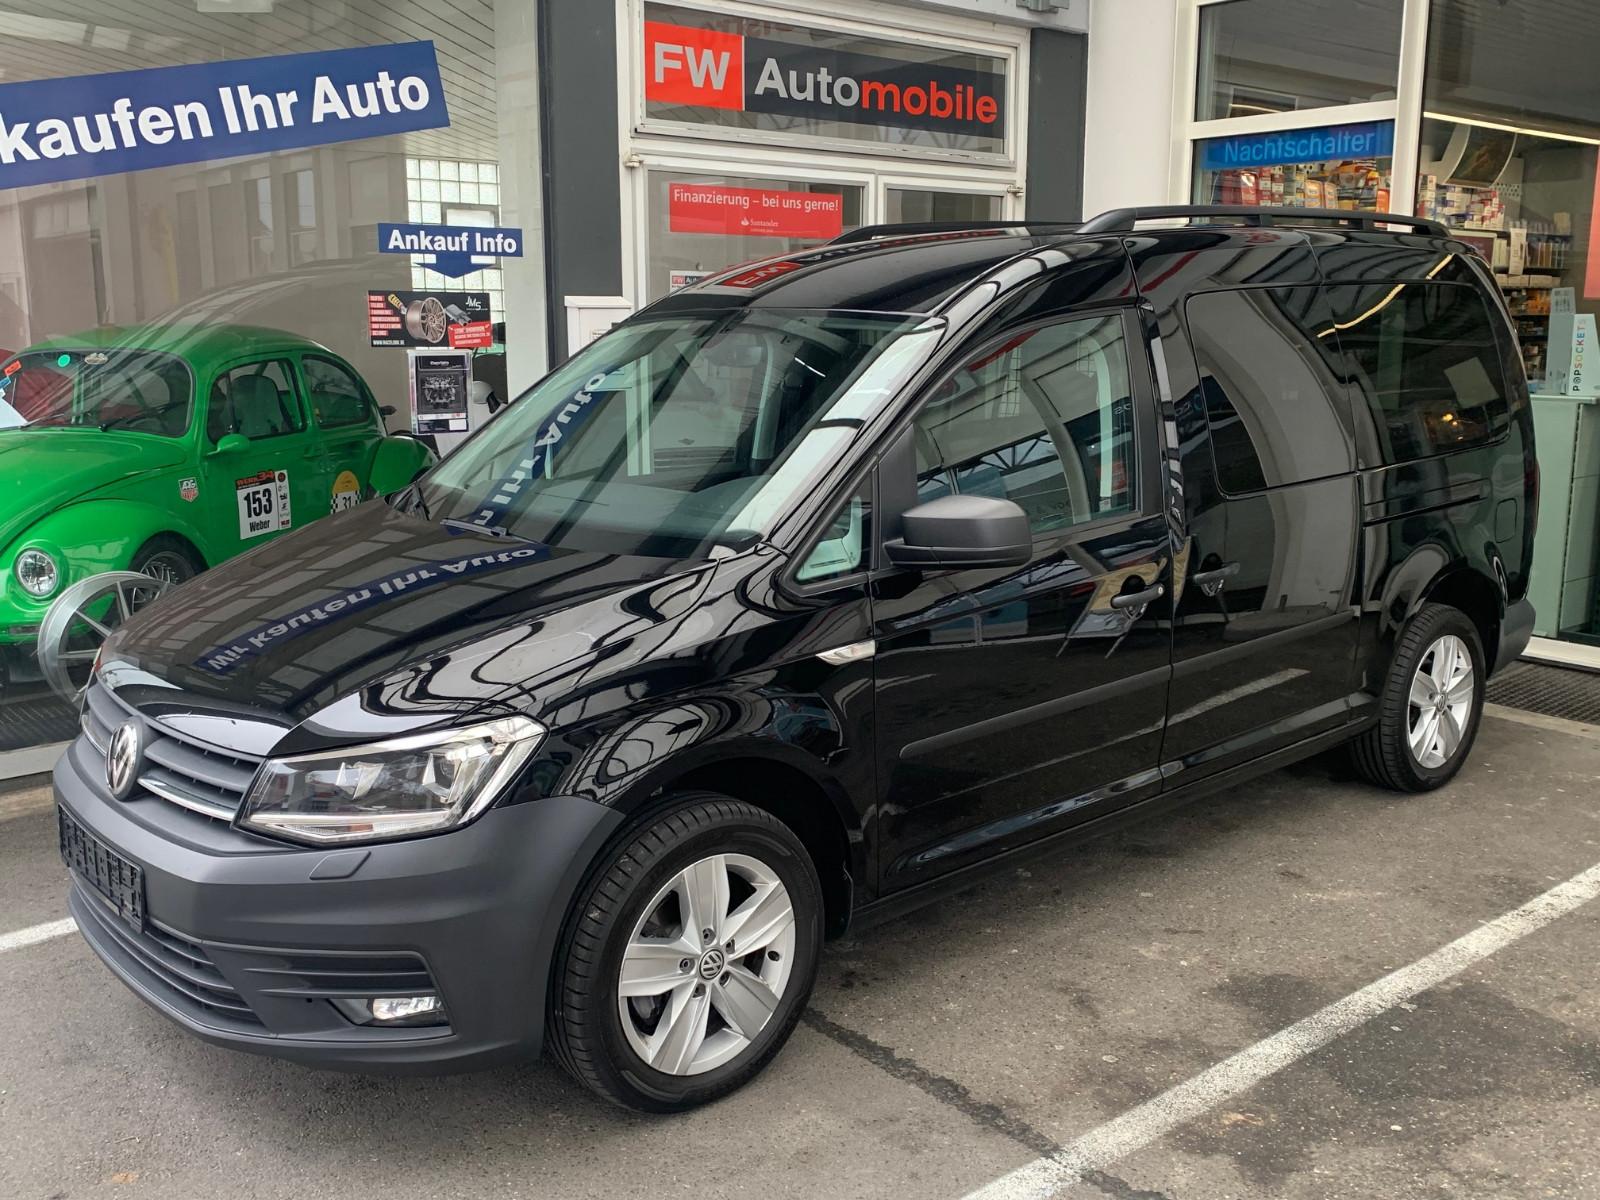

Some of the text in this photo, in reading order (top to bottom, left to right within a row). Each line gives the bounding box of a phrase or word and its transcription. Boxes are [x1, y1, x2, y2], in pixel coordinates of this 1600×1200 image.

[654, 41, 999, 124] FW Automobile
[0, 70, 430, 165] kaufen Ihr Auto
[1224, 129, 1376, 163] Nachtschalter
[673, 188, 750, 209] Finanzierung
[762, 194, 779, 208] bei
[782, 198, 802, 209] uns
[804, 199, 839, 213] gerne!
[388, 229, 517, 255] Ankauf Info
[244, 488, 273, 519] 153
[249, 519, 271, 533] Weber
